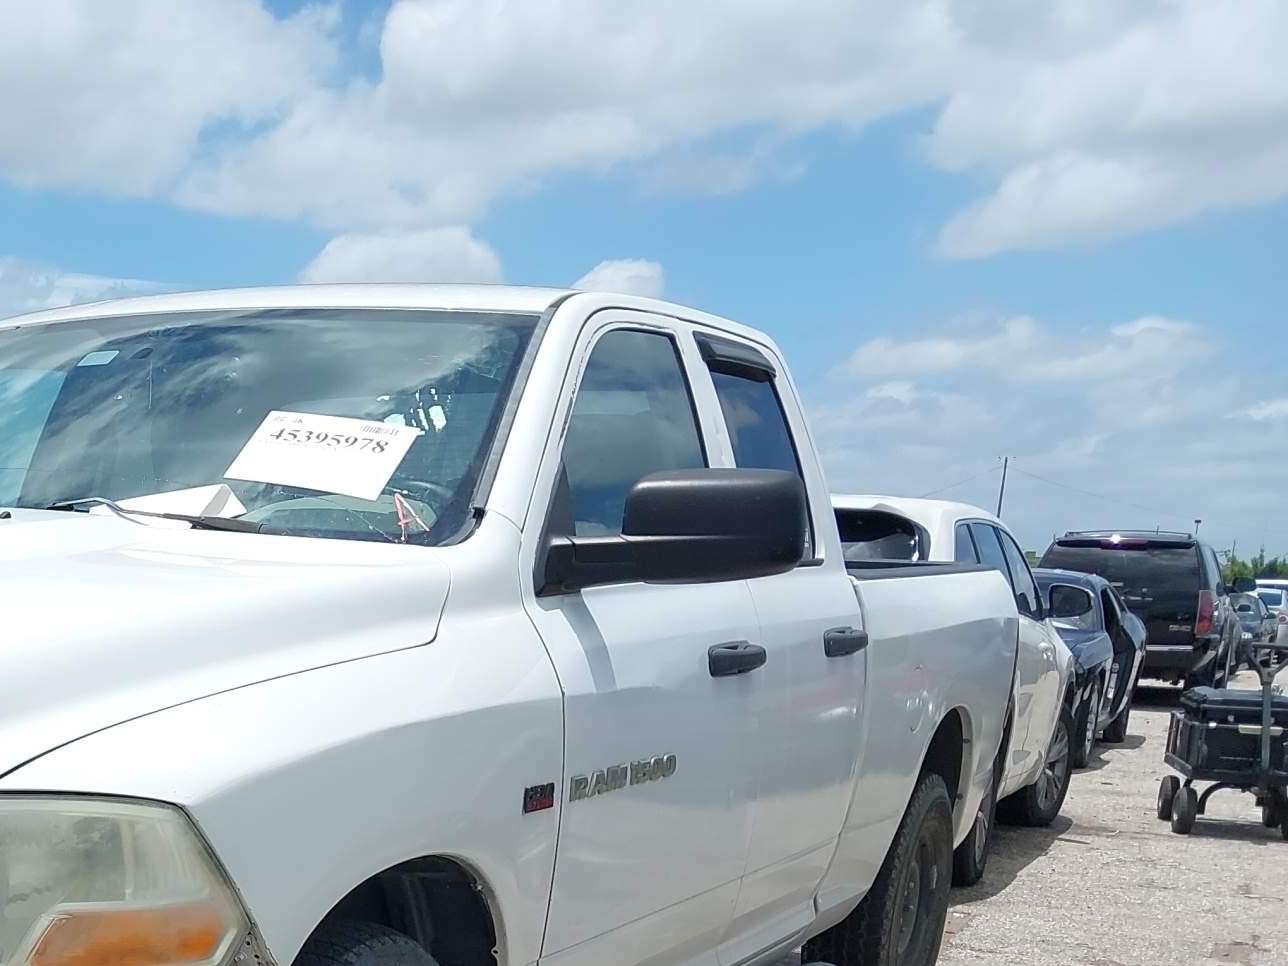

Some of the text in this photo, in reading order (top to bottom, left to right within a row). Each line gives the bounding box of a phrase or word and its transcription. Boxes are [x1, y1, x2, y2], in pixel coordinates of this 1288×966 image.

[269, 427, 389, 454] 45395978
[568, 763, 628, 802] RAM
[629, 752, 678, 787] 1500
